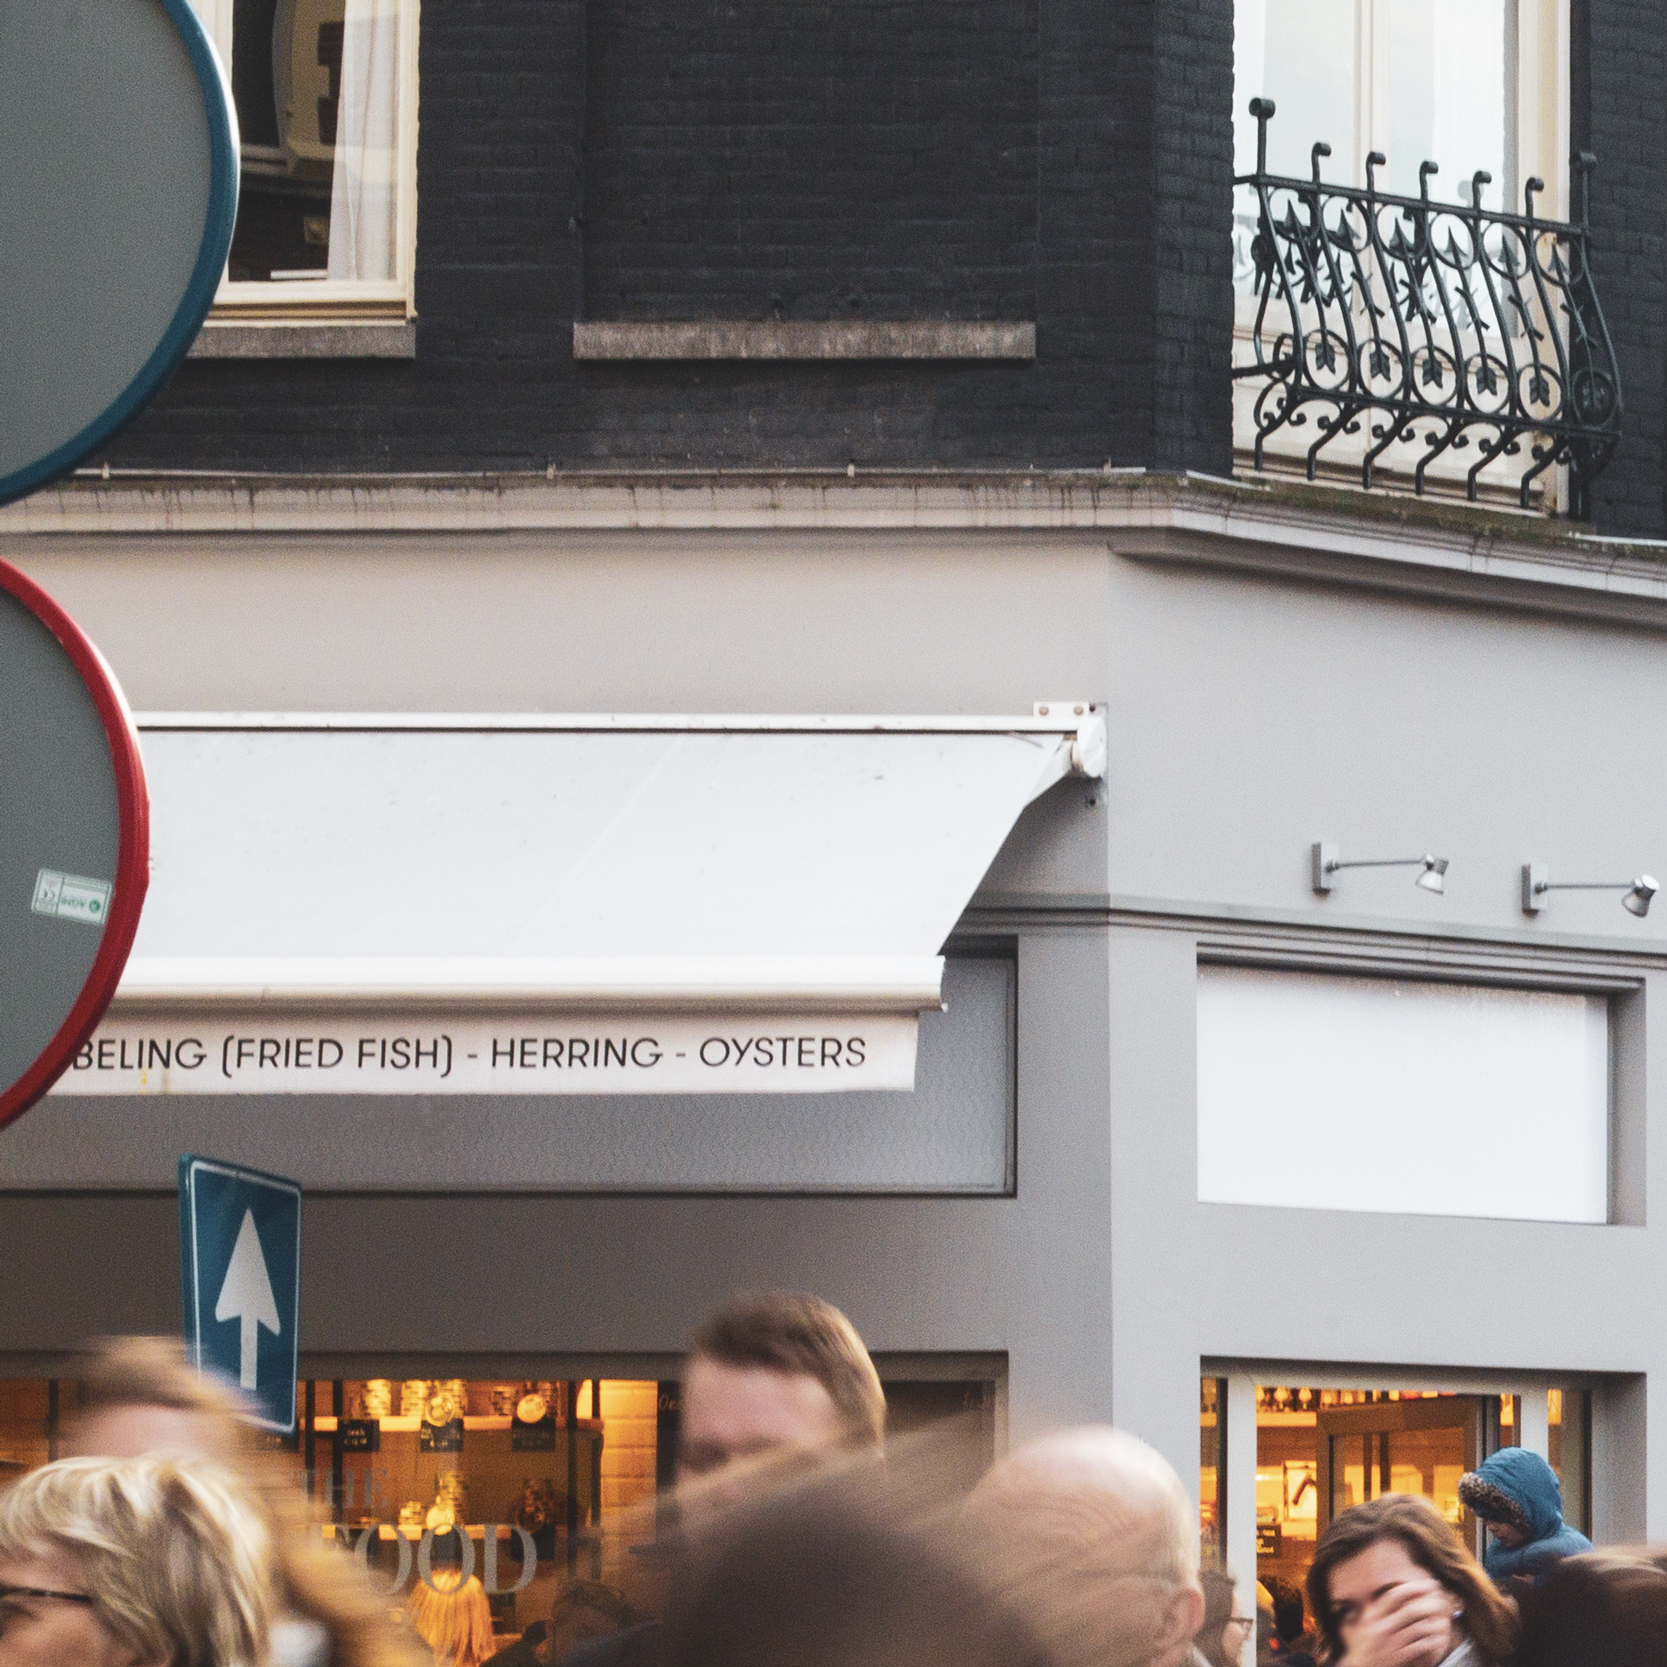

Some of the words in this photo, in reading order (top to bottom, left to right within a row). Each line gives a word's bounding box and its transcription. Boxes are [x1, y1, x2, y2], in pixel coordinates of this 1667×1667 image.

[222, 1035, 344, 1078] (FRIED
[357, 1034, 453, 1078] FISH)
[491, 1037, 664, 1069] HERRING
[699, 1036, 867, 1068] OYSTERS
[334, 1522, 538, 1595] OOD
